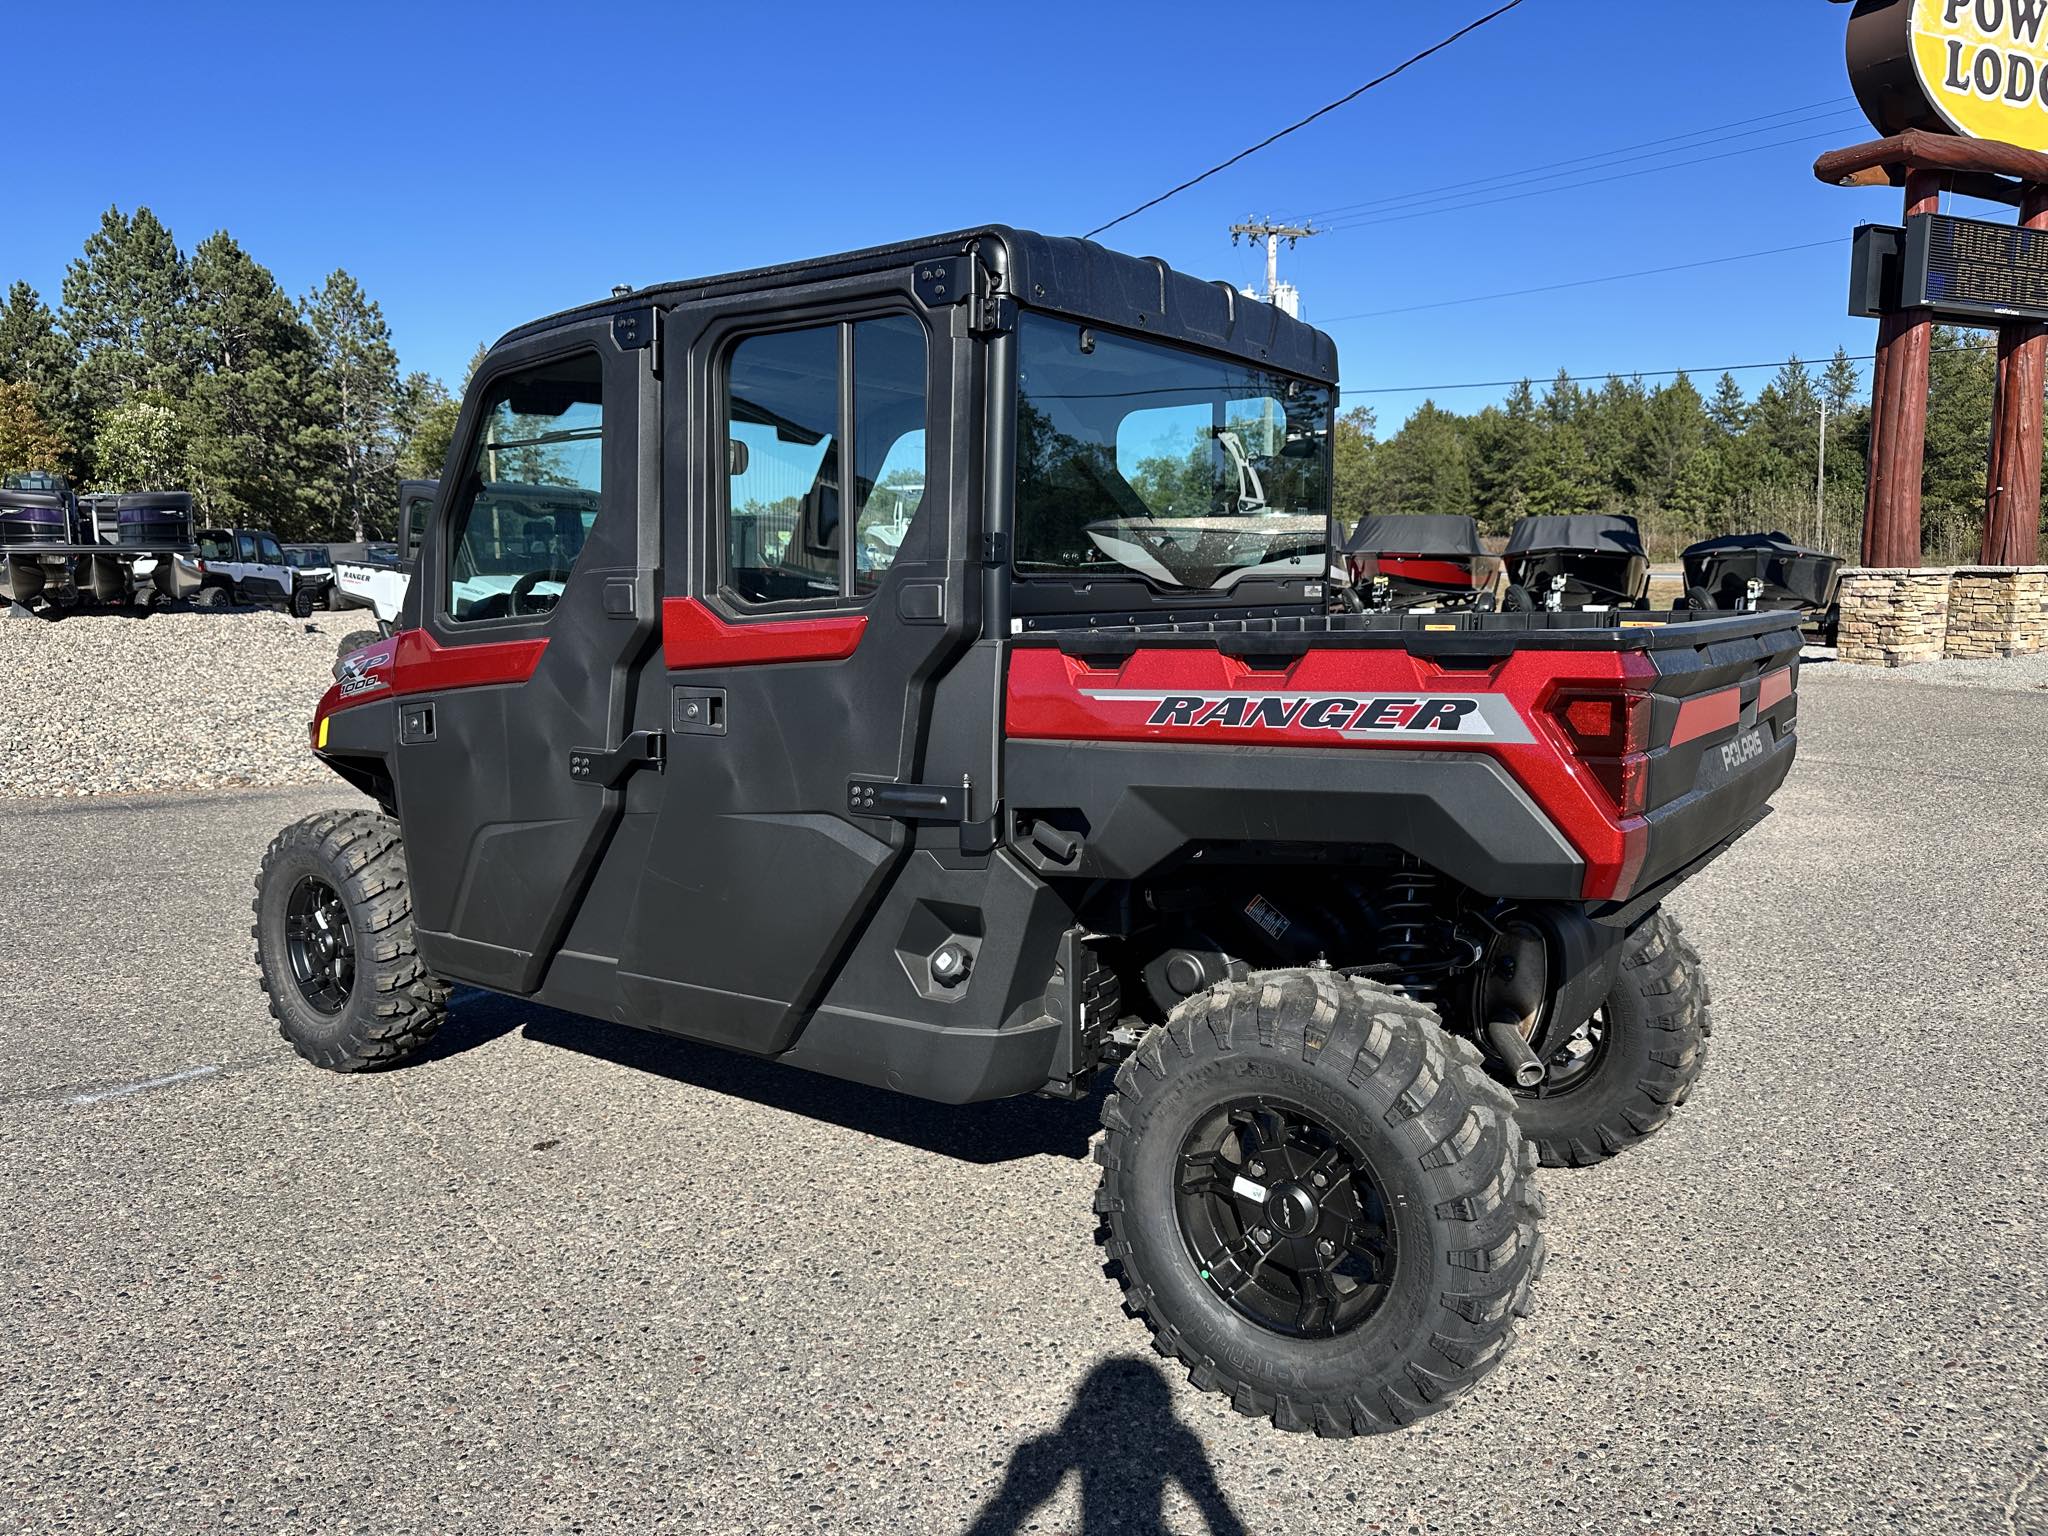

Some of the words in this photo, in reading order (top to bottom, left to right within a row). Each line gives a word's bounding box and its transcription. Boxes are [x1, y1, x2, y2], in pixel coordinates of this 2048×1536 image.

[1944, 0, 2048, 43] POW
[1952, 222, 2012, 266] HUGE
[340, 674, 379, 695] 1000
[1146, 695, 1478, 731] RANGER
[1720, 729, 1763, 772] POLARIS
